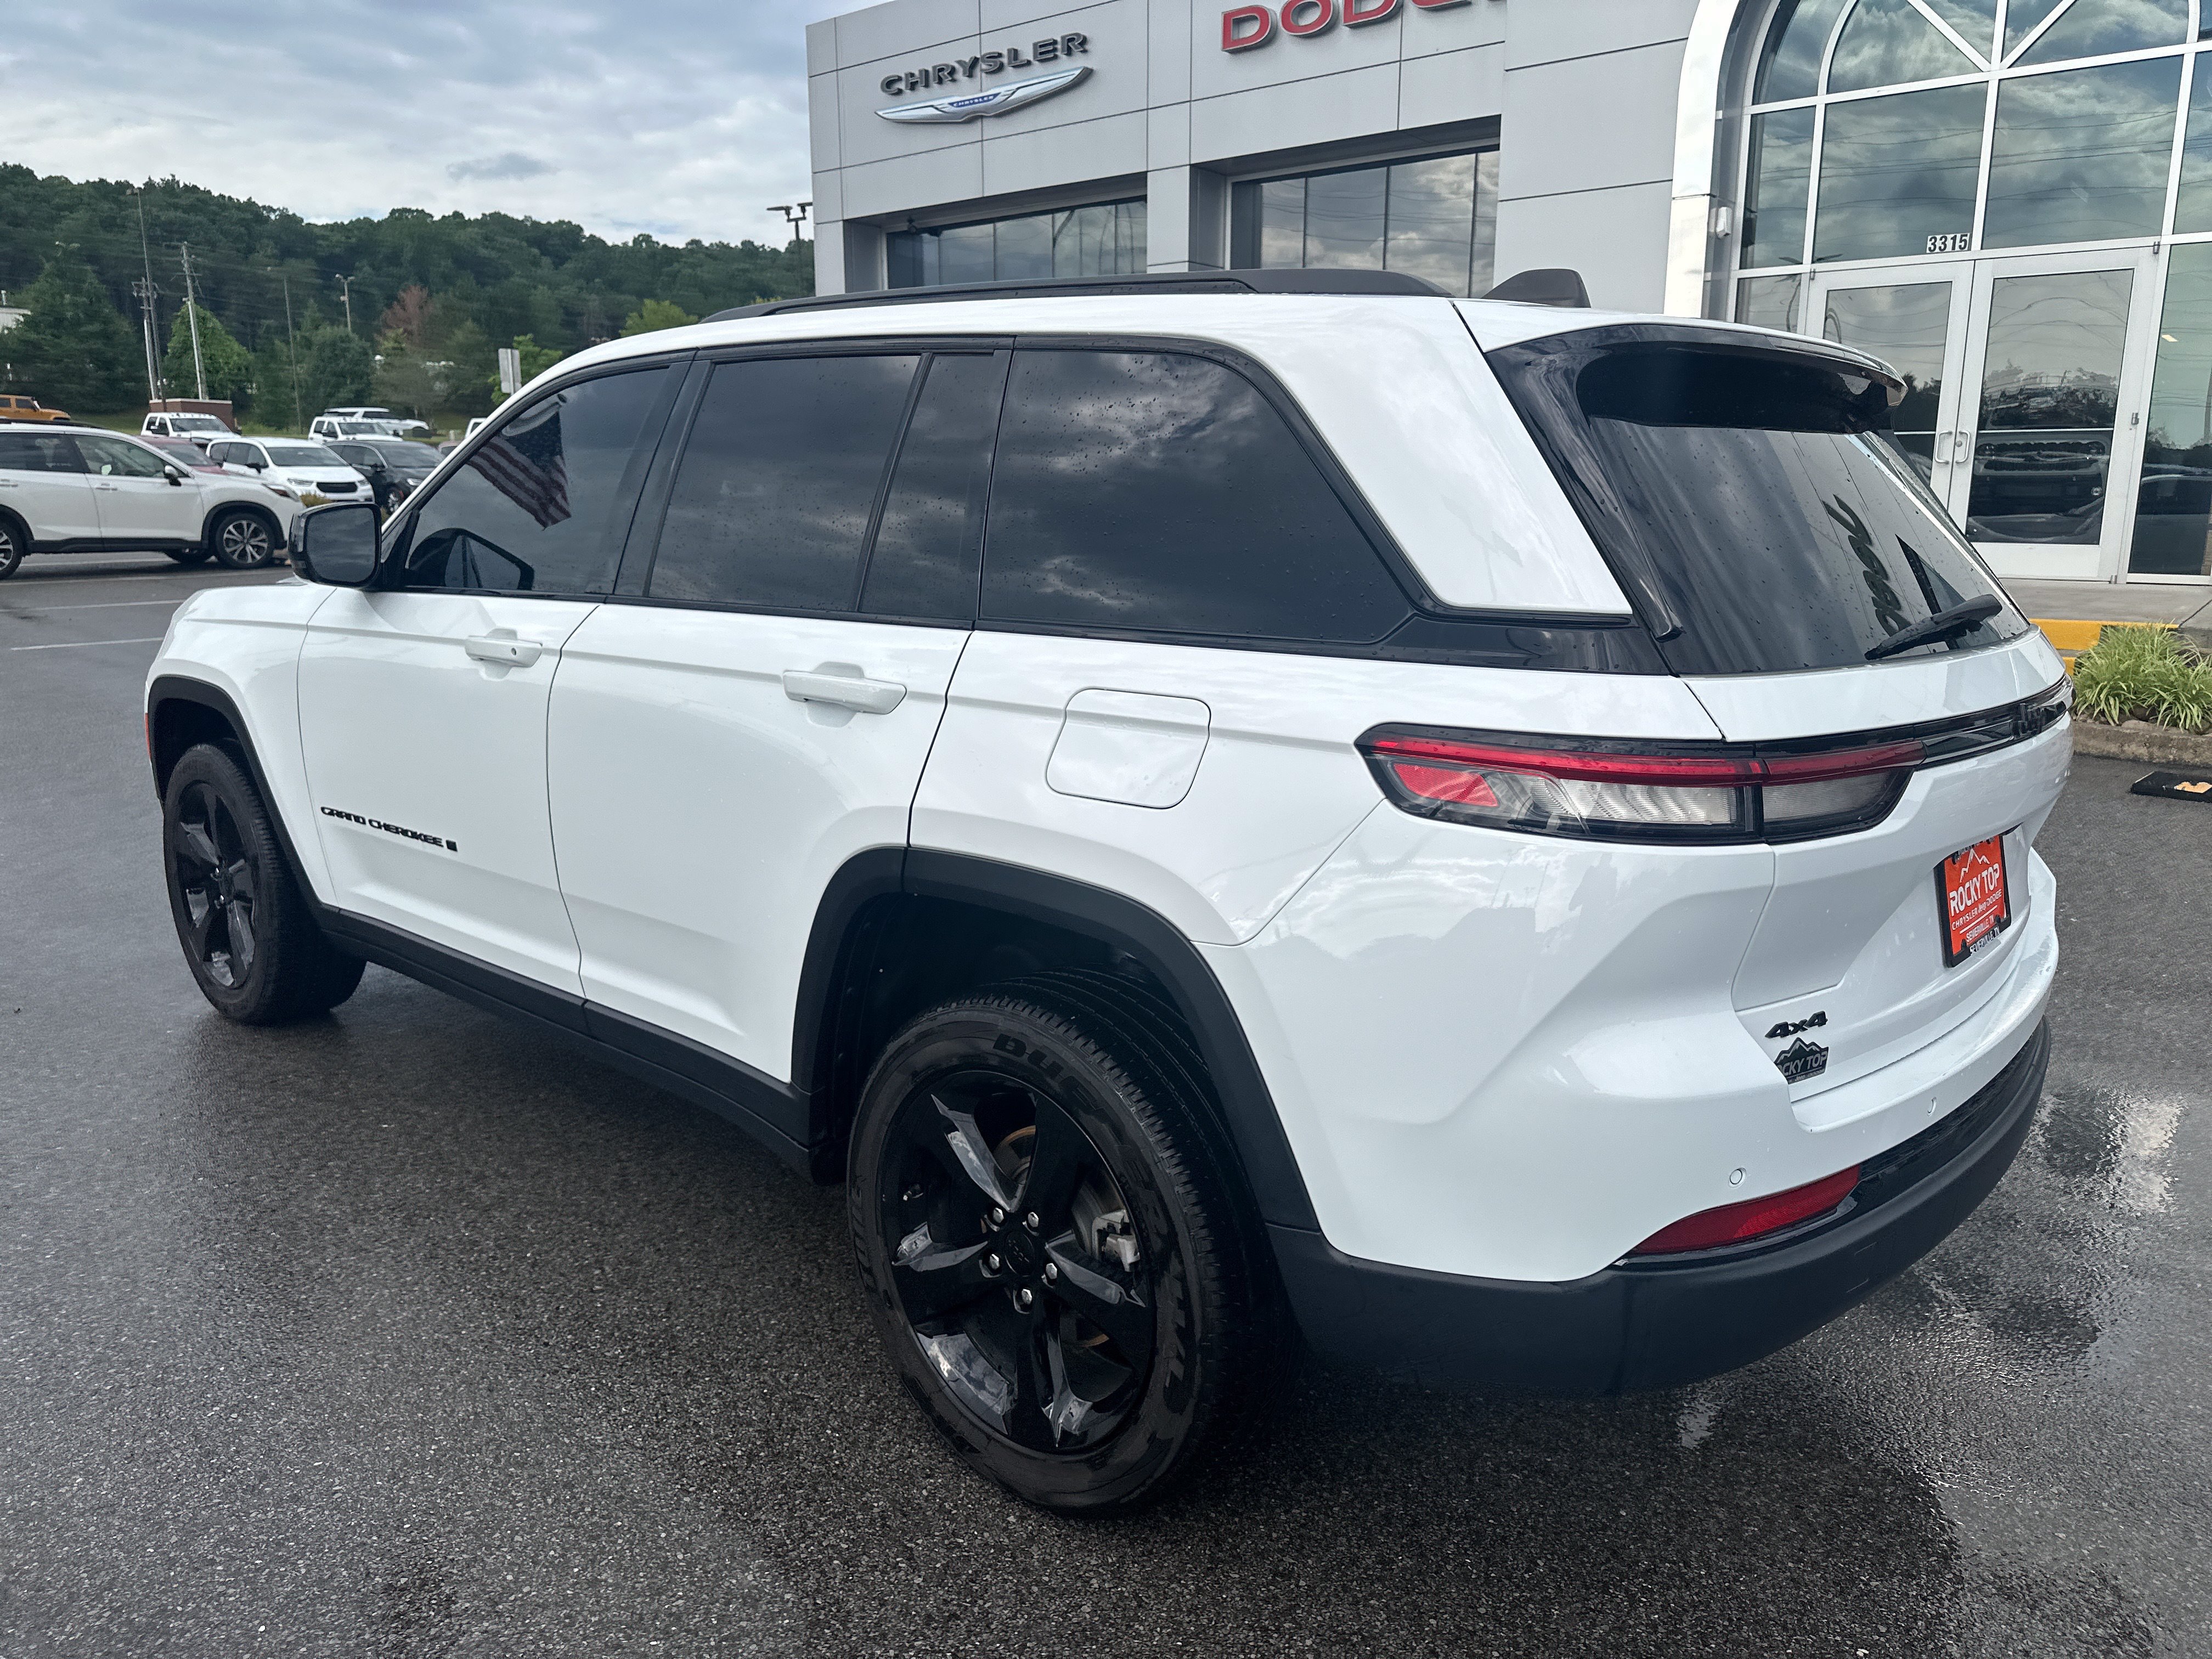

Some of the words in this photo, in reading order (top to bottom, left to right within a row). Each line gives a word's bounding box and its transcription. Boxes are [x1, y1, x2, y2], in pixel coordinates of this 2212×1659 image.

[881, 32, 1088, 94] CHRYSLER
[1928, 234, 1968, 252] 3315
[320, 806, 366, 825] GRAND
[368, 819, 444, 847] CHEROKEE
[1949, 877, 1980, 917] ROCKY
[1981, 863, 2000, 894] TOP
[1952, 907, 1977, 930] CHRYSLER
[1986, 888, 2002, 906] DODGE
[1765, 1011, 1828, 1039] 4x4
[1805, 1051, 1828, 1069] TOP
